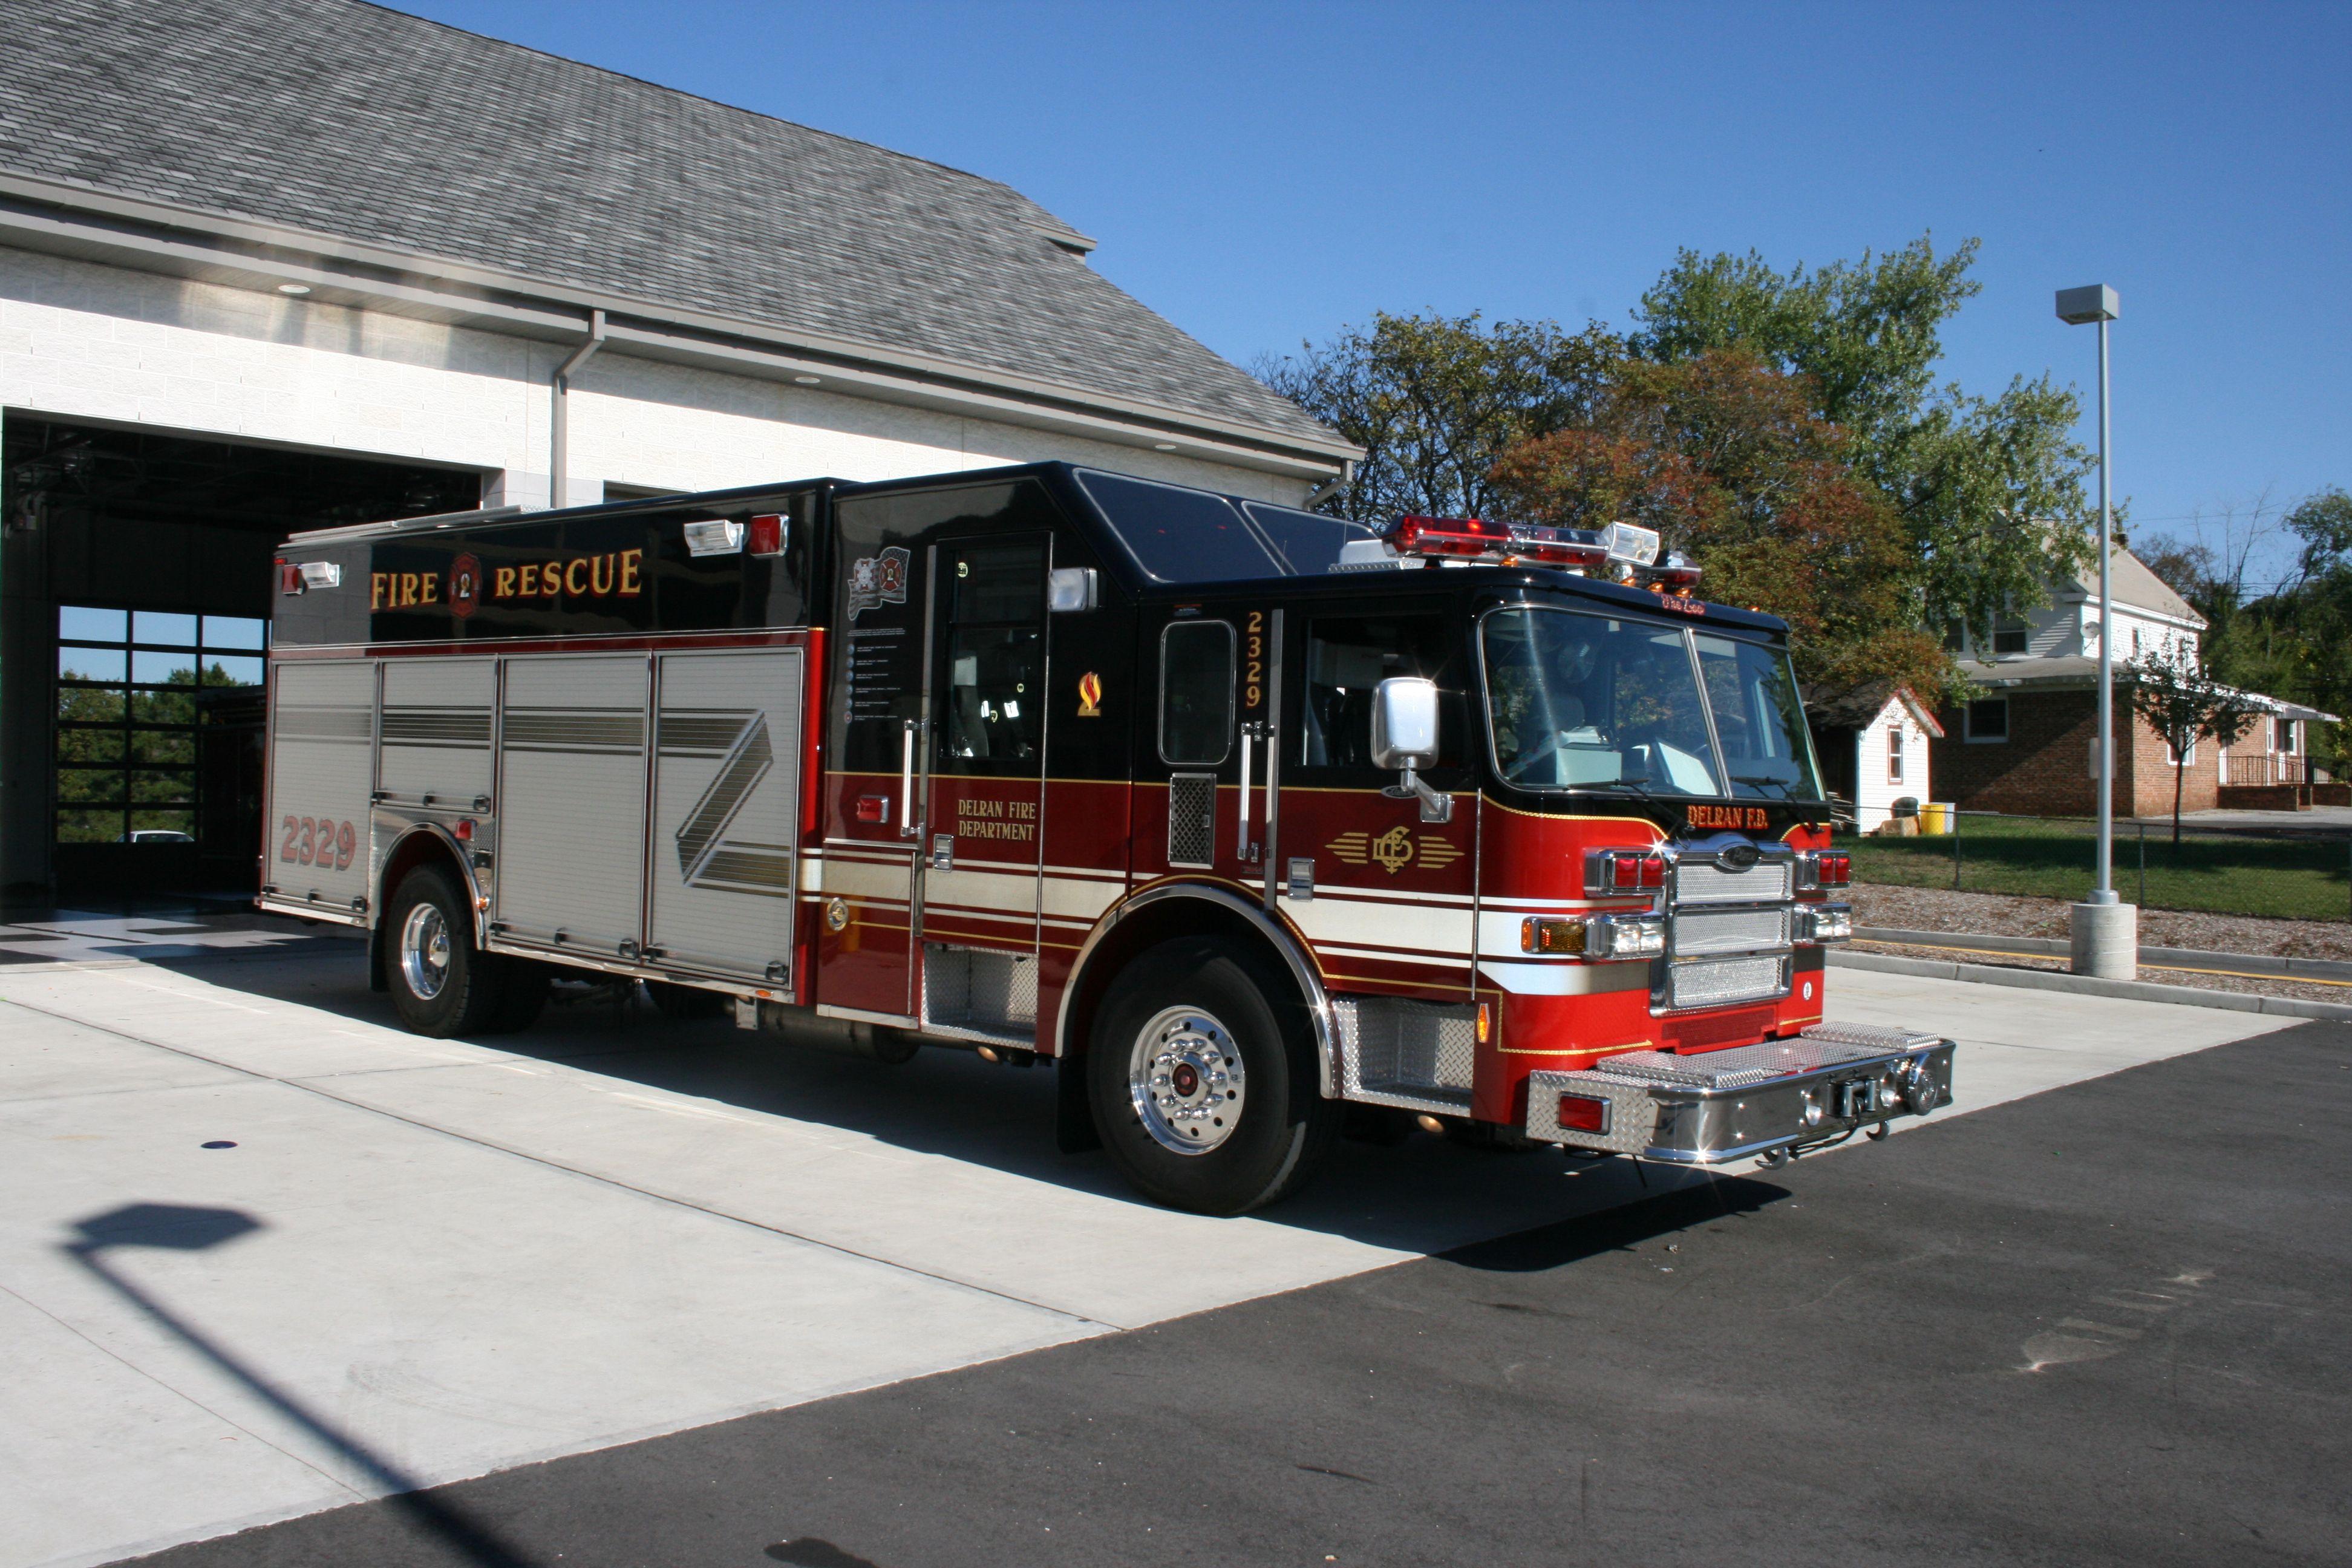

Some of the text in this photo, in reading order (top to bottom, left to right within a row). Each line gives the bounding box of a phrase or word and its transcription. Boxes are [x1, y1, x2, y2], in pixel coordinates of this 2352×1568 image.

[371, 572, 439, 612] FIRE
[494, 547, 642, 599] RESCUE
[1246, 611, 1263, 708] 2329
[958, 799, 1036, 820] DELRAN FIRE
[1688, 805, 1769, 829] DELRAN F.D.
[281, 815, 356, 871] 2329
[958, 820, 1035, 841] DEPARTMENT
